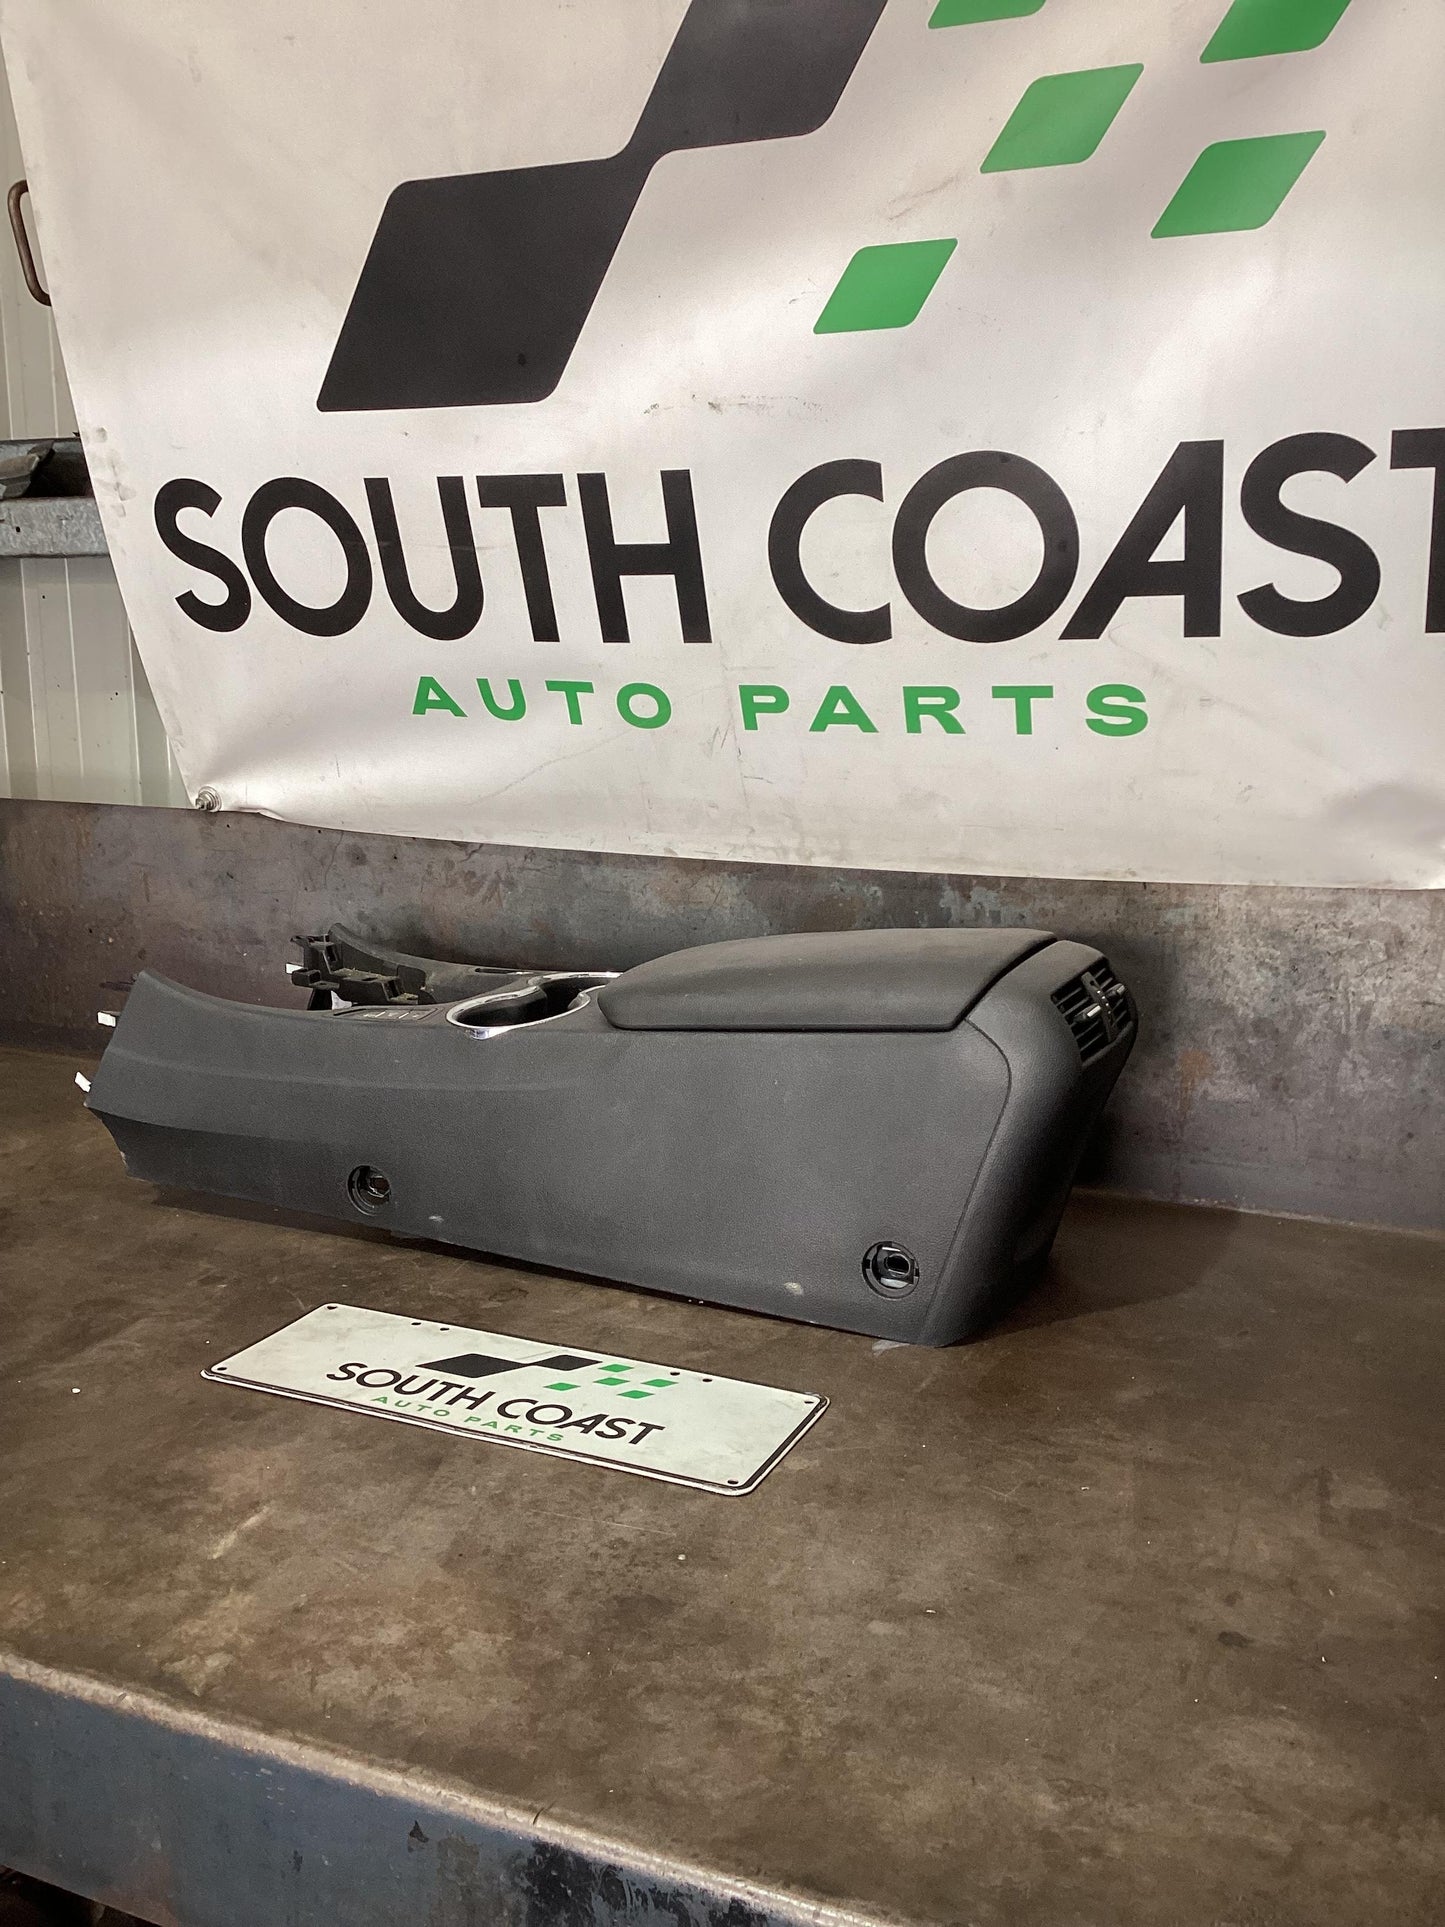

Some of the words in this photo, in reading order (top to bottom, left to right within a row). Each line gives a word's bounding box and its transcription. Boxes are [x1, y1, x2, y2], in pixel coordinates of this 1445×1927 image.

[154, 469, 712, 643] SOUTH
[412, 676, 673, 730] AUTO
[738, 684, 1149, 737] PARTS
[326, 1362, 496, 1411] SOUTH
[497, 1398, 666, 1445] COAST
[371, 1396, 451, 1418] AUTO
[464, 1416, 564, 1442] PARTS
